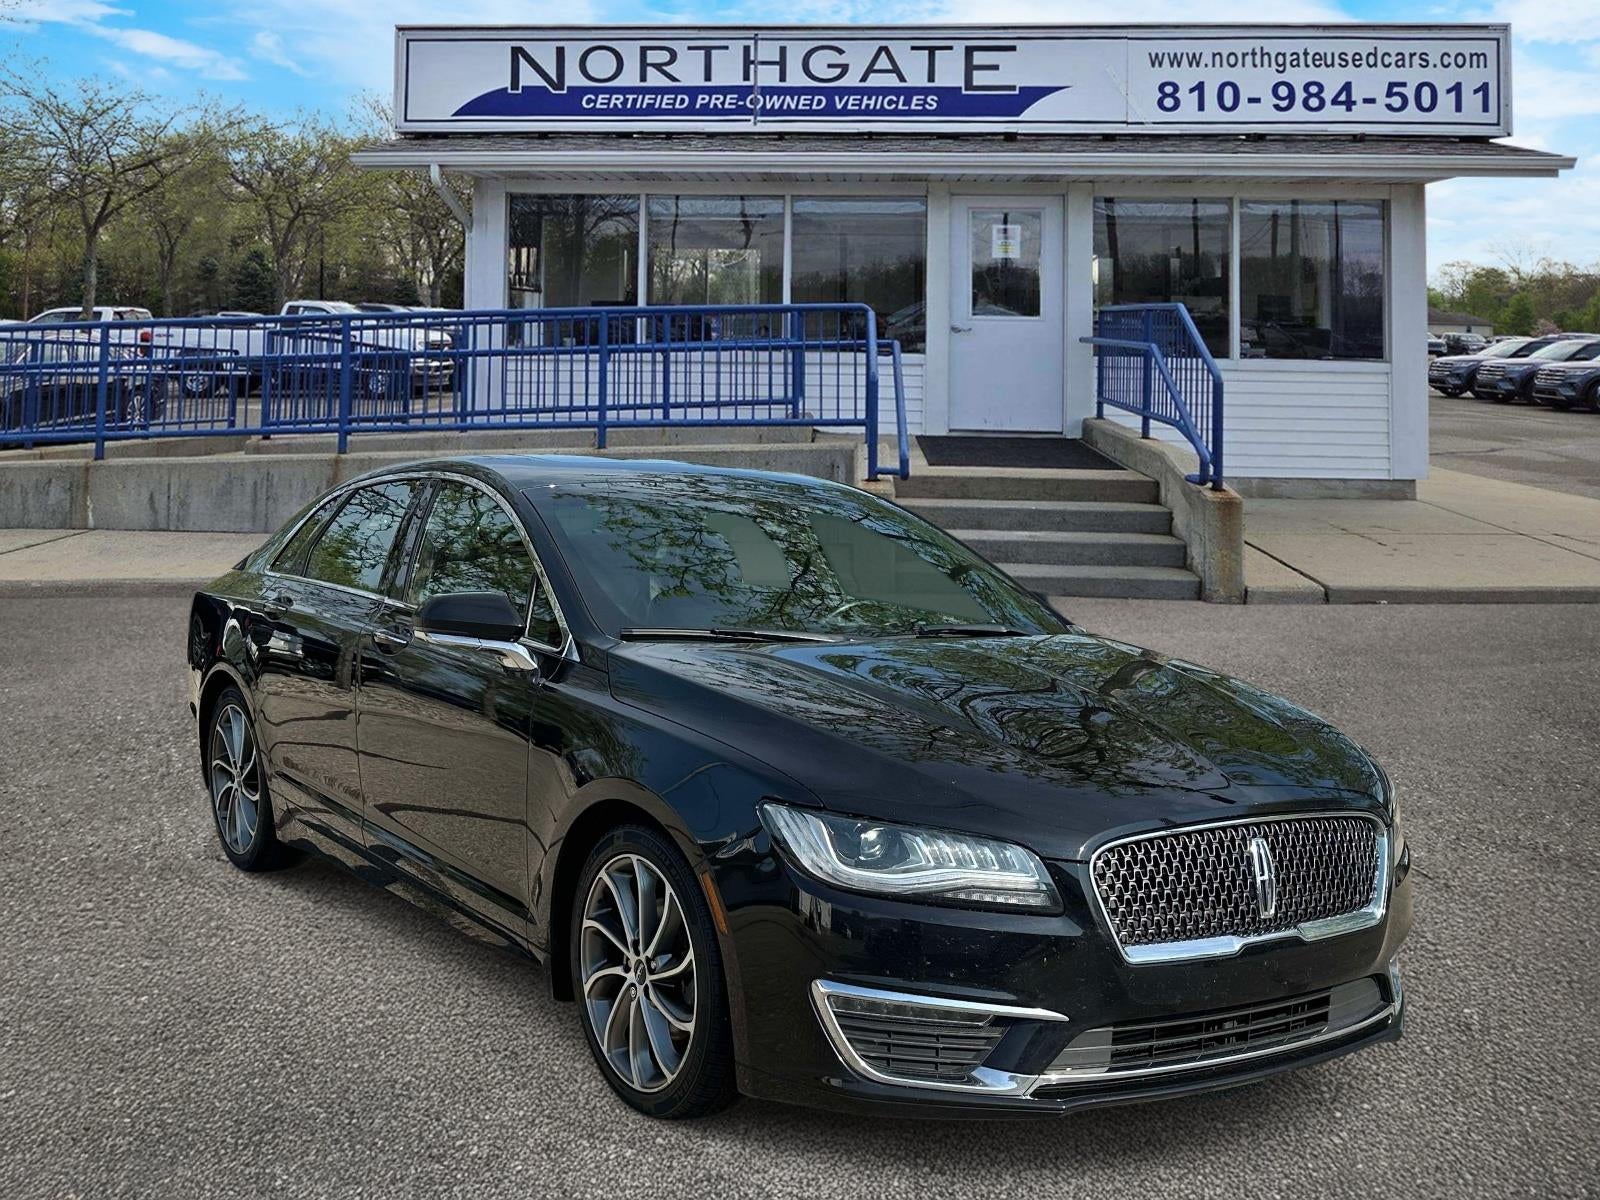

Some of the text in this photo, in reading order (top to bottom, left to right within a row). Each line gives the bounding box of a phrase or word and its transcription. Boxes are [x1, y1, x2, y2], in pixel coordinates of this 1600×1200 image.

[510, 44, 1018, 92] NORTHGATE
[1148, 46, 1489, 73] www.northgateusedcars.com
[581, 94, 939, 111] CERTIFIED PRE-OWNED VEHICLES
[1156, 80, 1491, 114] 810-984-5011
